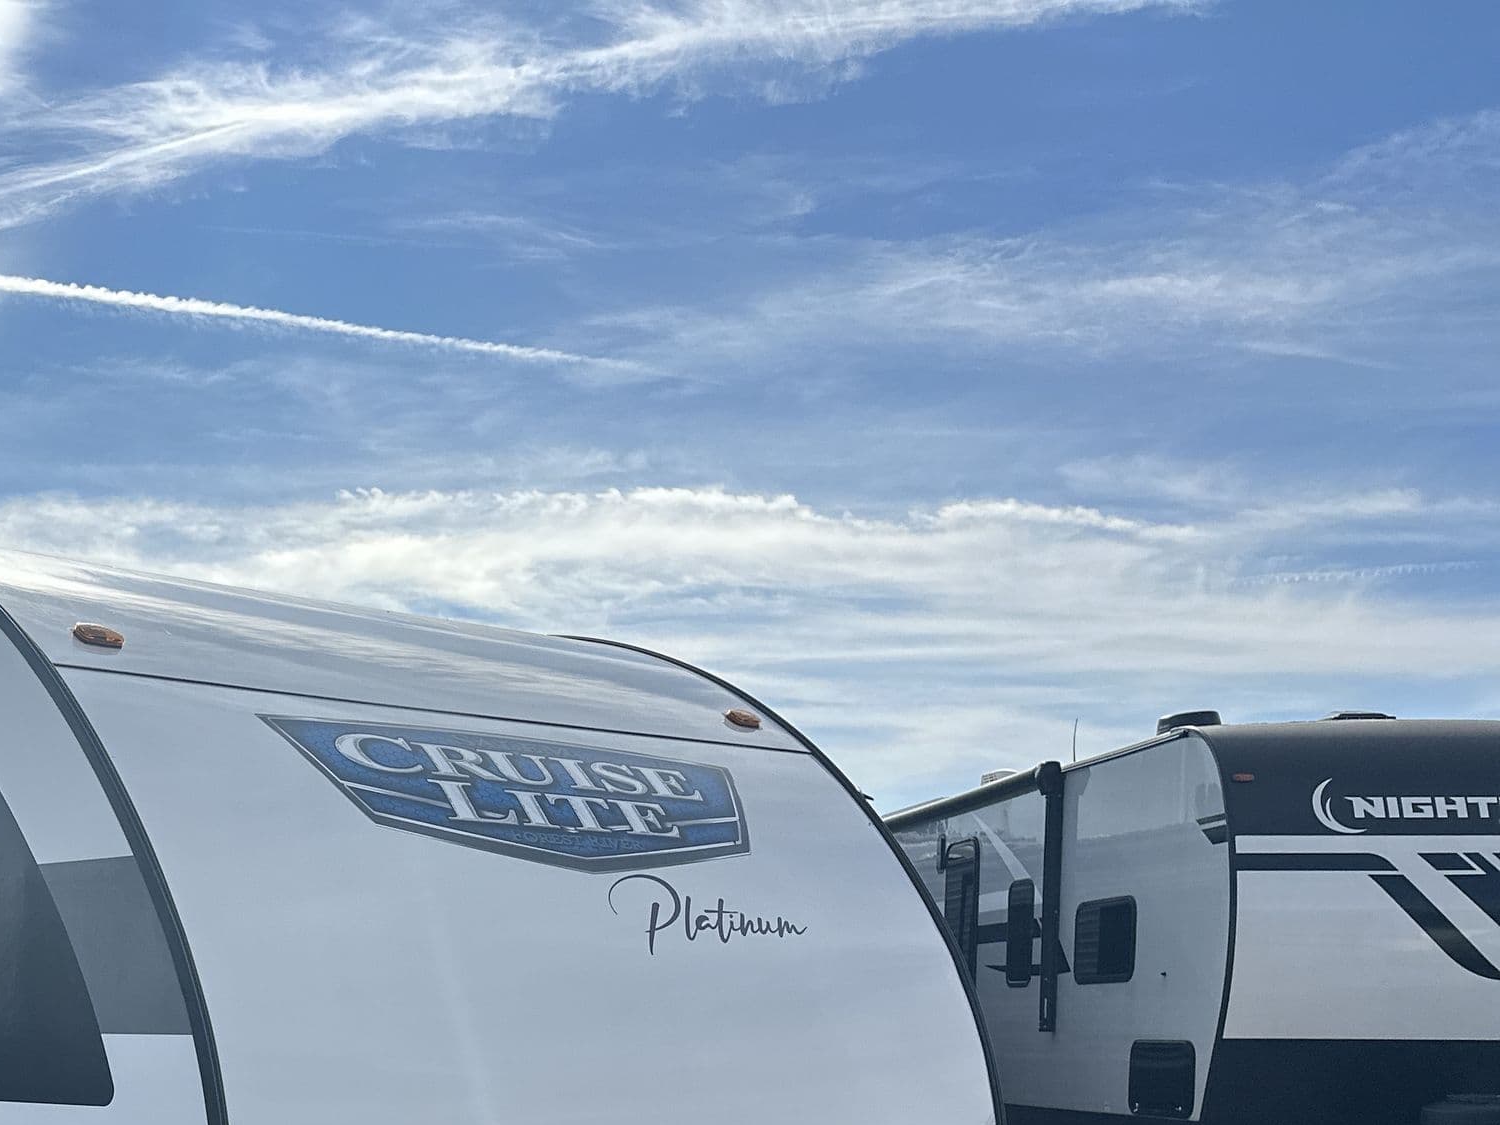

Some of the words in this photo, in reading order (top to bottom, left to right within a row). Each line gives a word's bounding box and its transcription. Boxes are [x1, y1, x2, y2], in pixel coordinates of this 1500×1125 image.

[334, 733, 703, 801] CRUISE
[427, 778, 681, 839] LITE
[1344, 796, 1500, 819] NIGHT
[608, 873, 808, 956] Platinum
